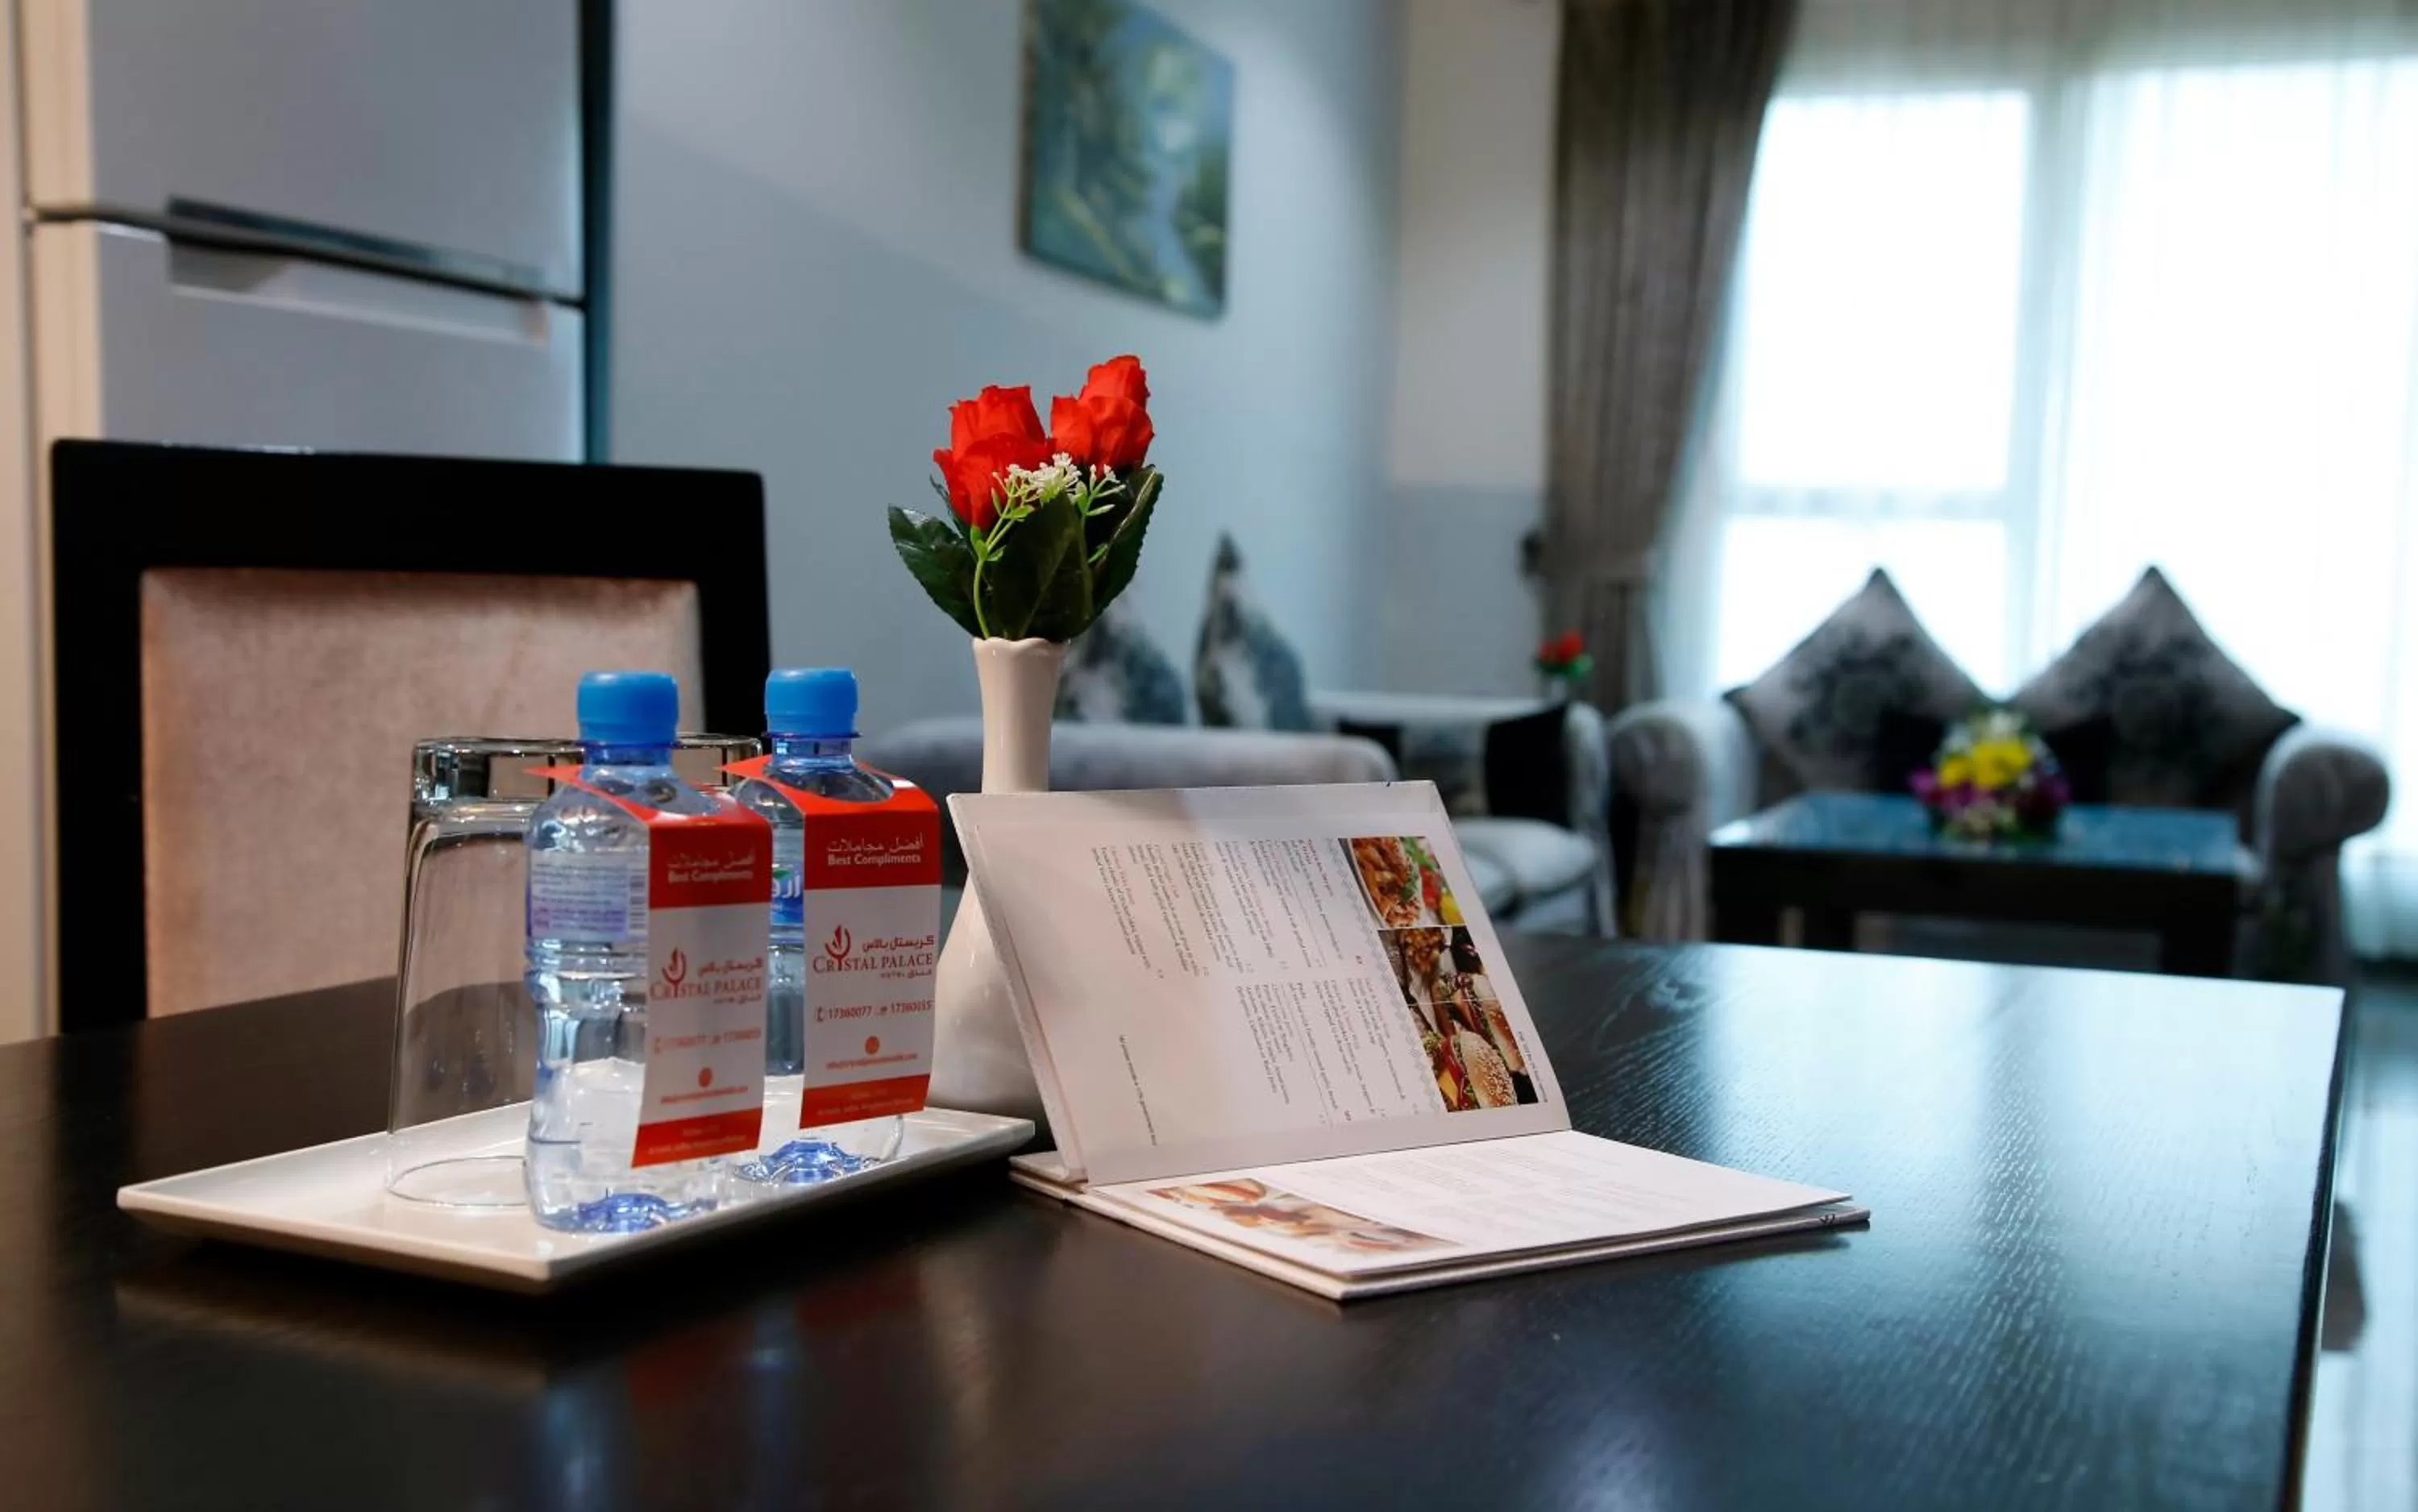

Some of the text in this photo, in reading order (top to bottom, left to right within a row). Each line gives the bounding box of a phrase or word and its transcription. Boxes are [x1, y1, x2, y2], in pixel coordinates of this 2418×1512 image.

[827, 853, 921, 868] Best Compliments
[812, 943, 933, 974] CRYSTAL PALACE
